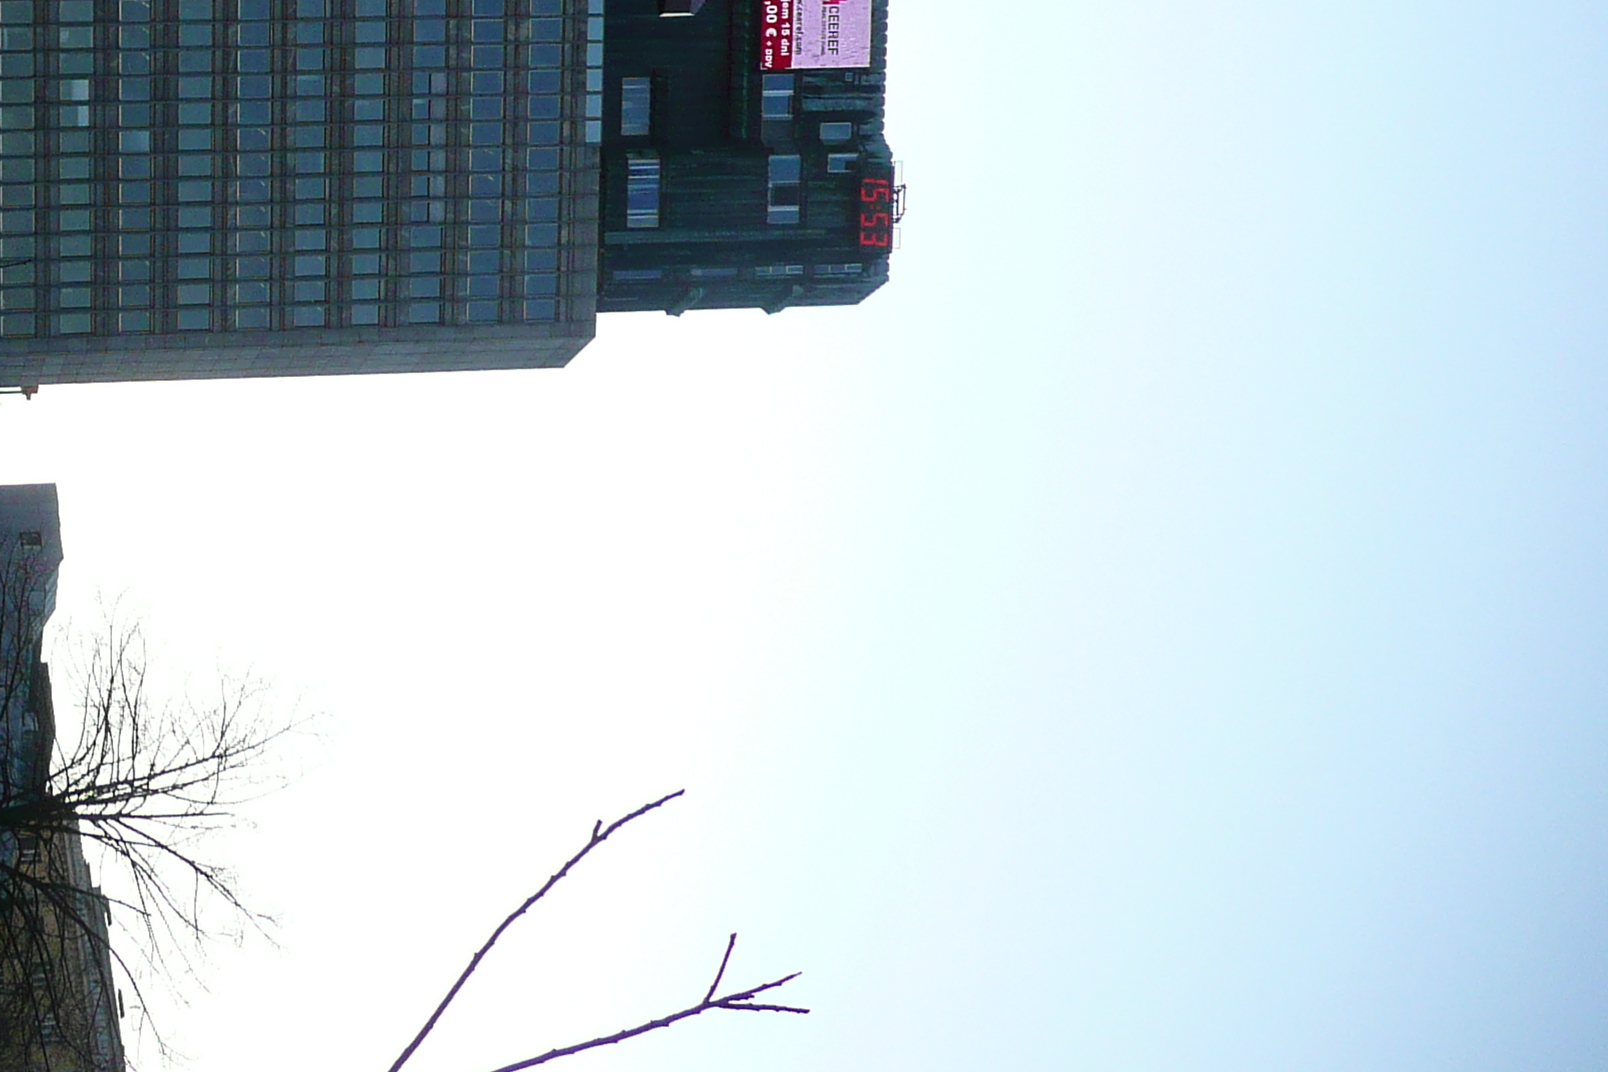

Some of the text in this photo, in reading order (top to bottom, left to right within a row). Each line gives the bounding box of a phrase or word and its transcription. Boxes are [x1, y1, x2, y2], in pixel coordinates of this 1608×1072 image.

[766, 28, 777, 38] €
[781, 22, 790, 36] 15
[828, 6, 840, 56] CEEREF
[860, 177, 890, 247] 15:53
